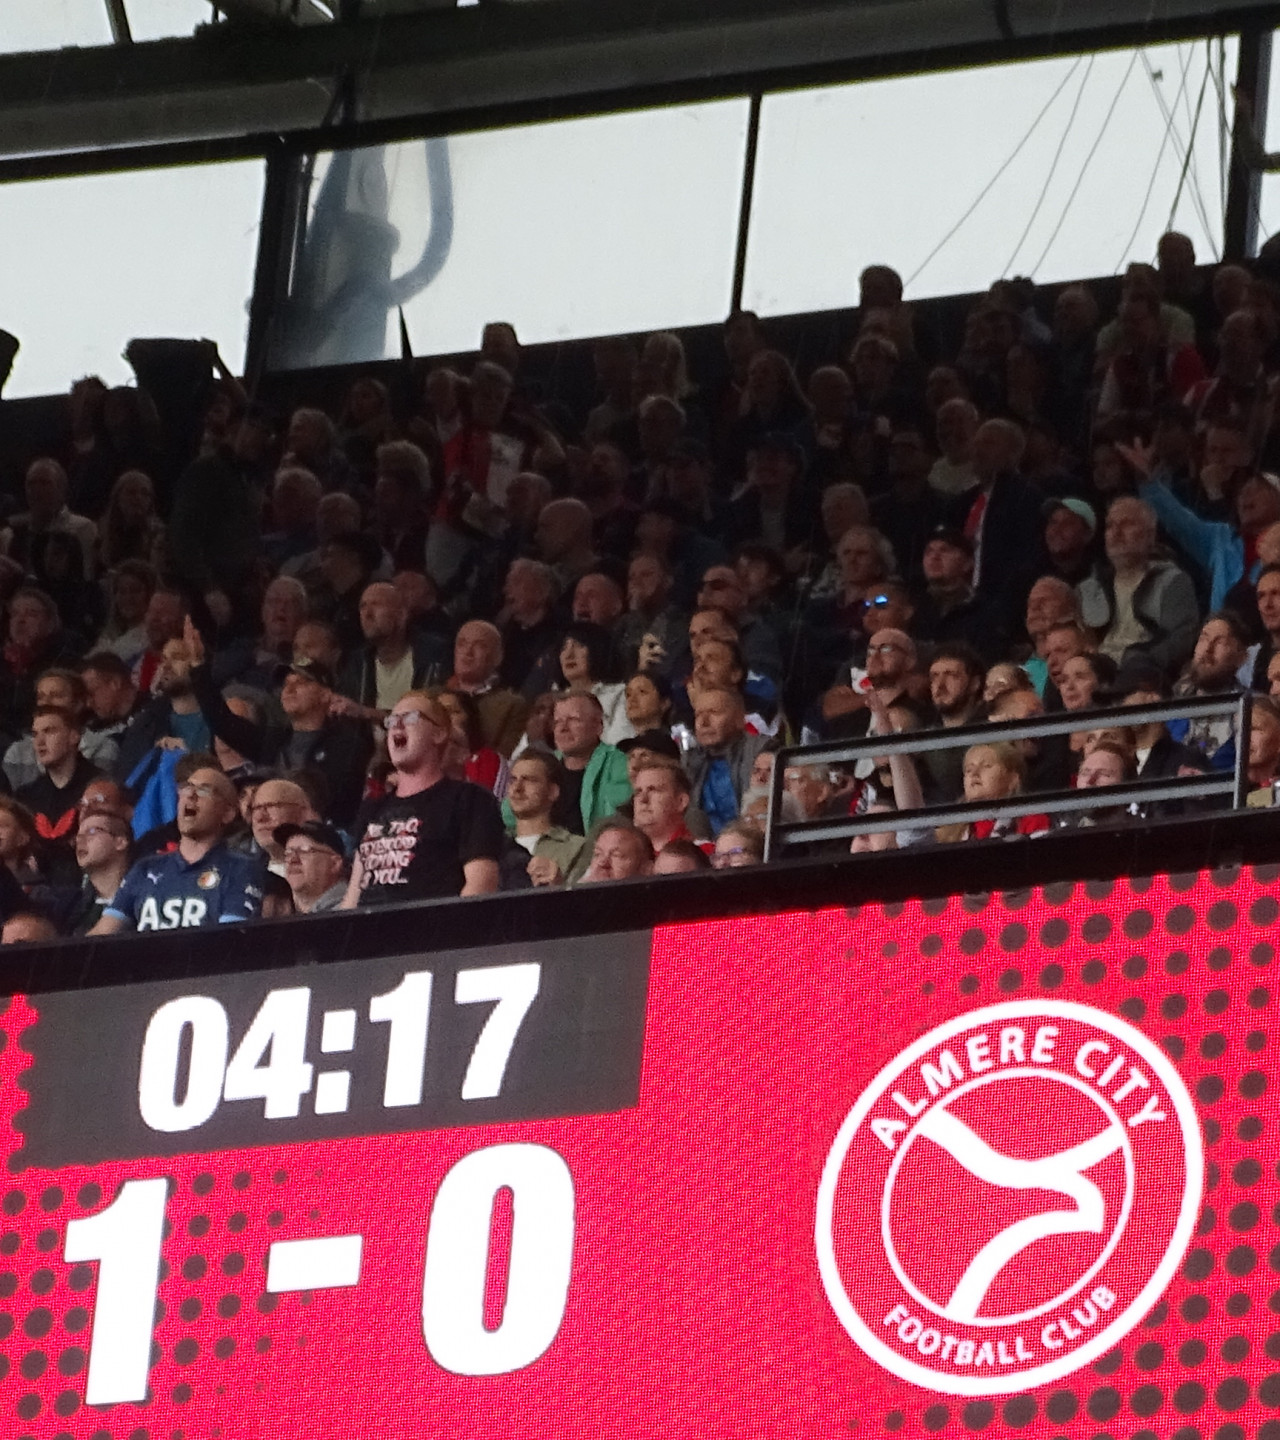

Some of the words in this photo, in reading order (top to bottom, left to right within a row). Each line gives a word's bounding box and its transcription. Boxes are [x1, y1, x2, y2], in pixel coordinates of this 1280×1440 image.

[136, 896, 206, 932] ASR
[138, 962, 542, 1133] 04:17
[870, 1025, 1060, 1150] ALMERE
[1075, 1041, 1167, 1128] CITY
[64, 1177, 169, 1405] 1
[420, 1142, 575, 1376] 0
[881, 1304, 1035, 1366] FOOTBALL
[1041, 1284, 1118, 1350] CLUB
